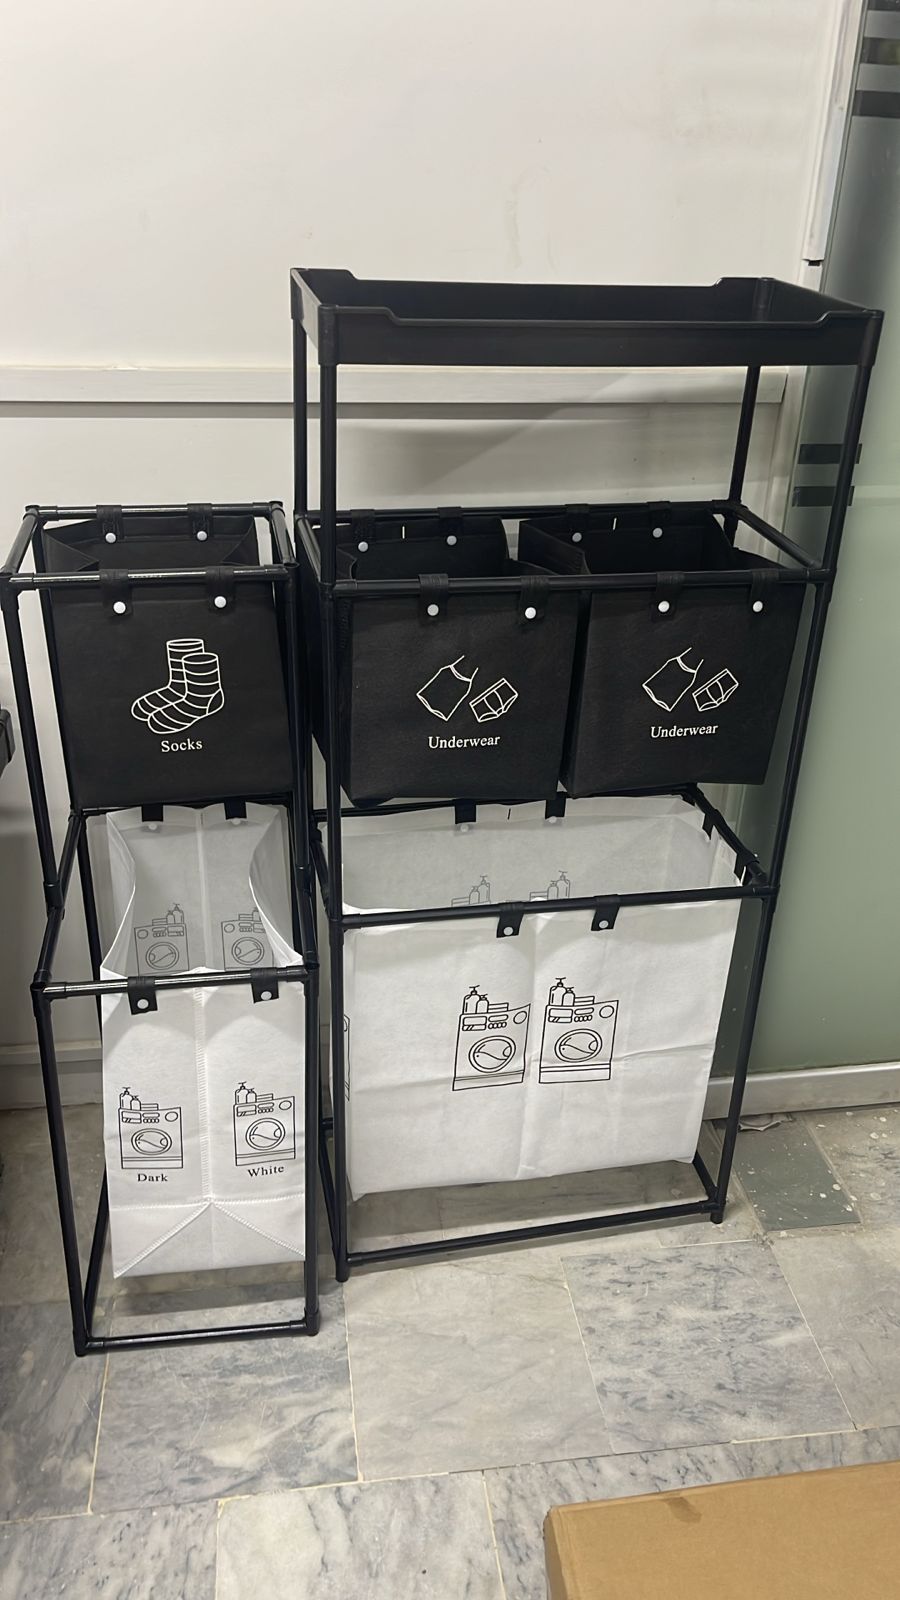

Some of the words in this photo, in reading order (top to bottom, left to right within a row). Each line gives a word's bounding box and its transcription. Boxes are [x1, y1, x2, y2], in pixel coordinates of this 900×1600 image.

[650, 725, 719, 739] Underwear
[160, 738, 203, 753] Socks
[428, 735, 501, 749] Underwear
[137, 1173, 168, 1183] Dark
[247, 1164, 285, 1178] White
